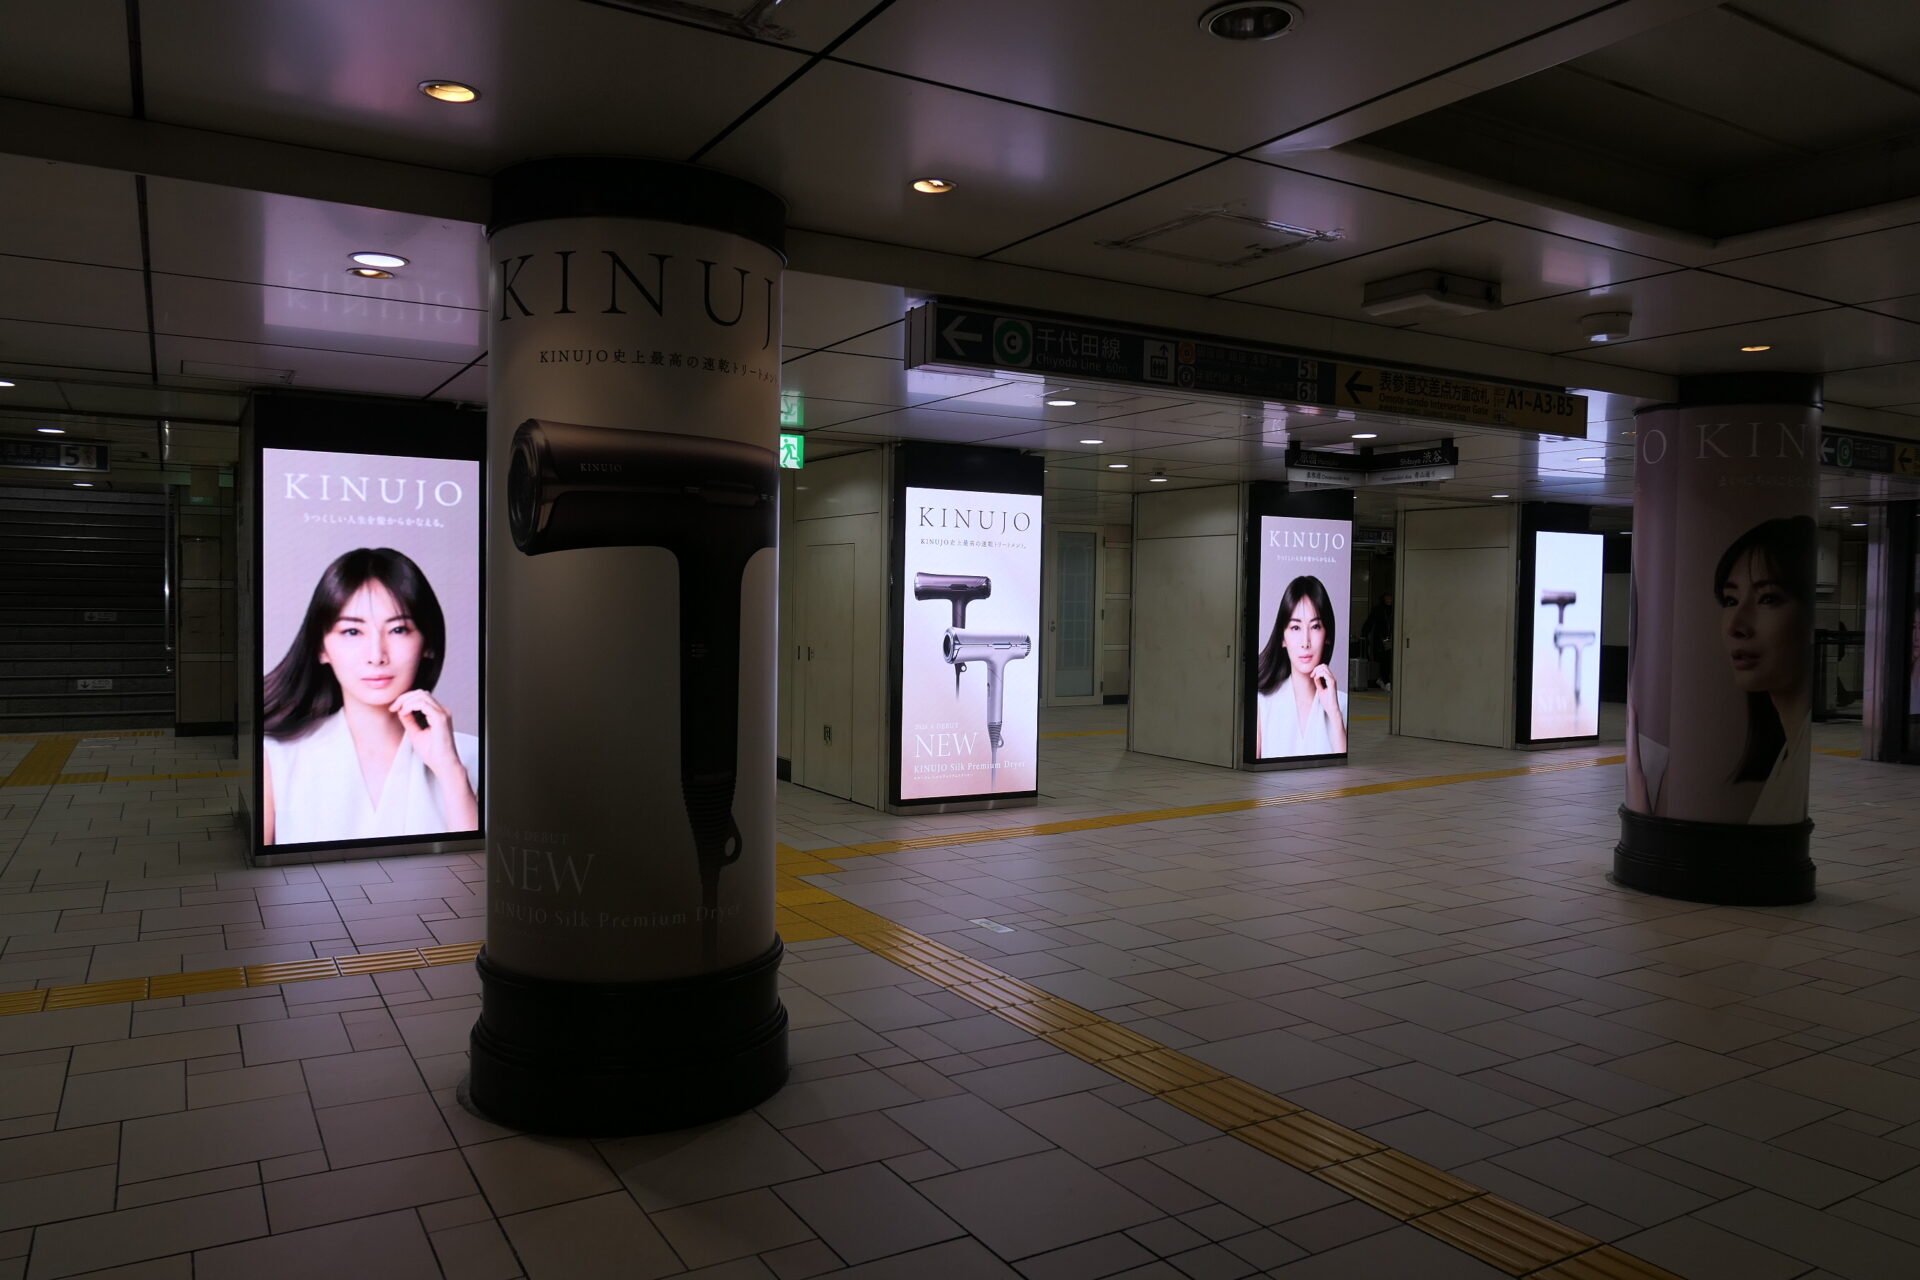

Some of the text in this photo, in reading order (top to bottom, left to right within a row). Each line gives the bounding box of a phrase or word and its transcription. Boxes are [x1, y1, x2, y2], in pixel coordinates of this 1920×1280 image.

[1035, 327, 1121, 360] 千代田線
[1036, 352, 1078, 368] Chiyoda
[1081, 358, 1102, 371] Line
[1300, 361, 1309, 377] 5
[1299, 383, 1309, 399] 6
[1379, 371, 1490, 404] 表参道交差点方面改札
[65, 446, 80, 466] 5
[579, 462, 624, 473] KINUJO
[284, 472, 463, 510] KINUJO
[919, 506, 1031, 535] KINUJO
[1269, 530, 1345, 553] KINUJO
[912, 732, 979, 758] NEW
[913, 760, 1026, 774] KINUJO Silk Premium Dryer
[496, 843, 596, 896] NEW
[554, 906, 591, 929] Silk
[600, 911, 688, 929] Premium
